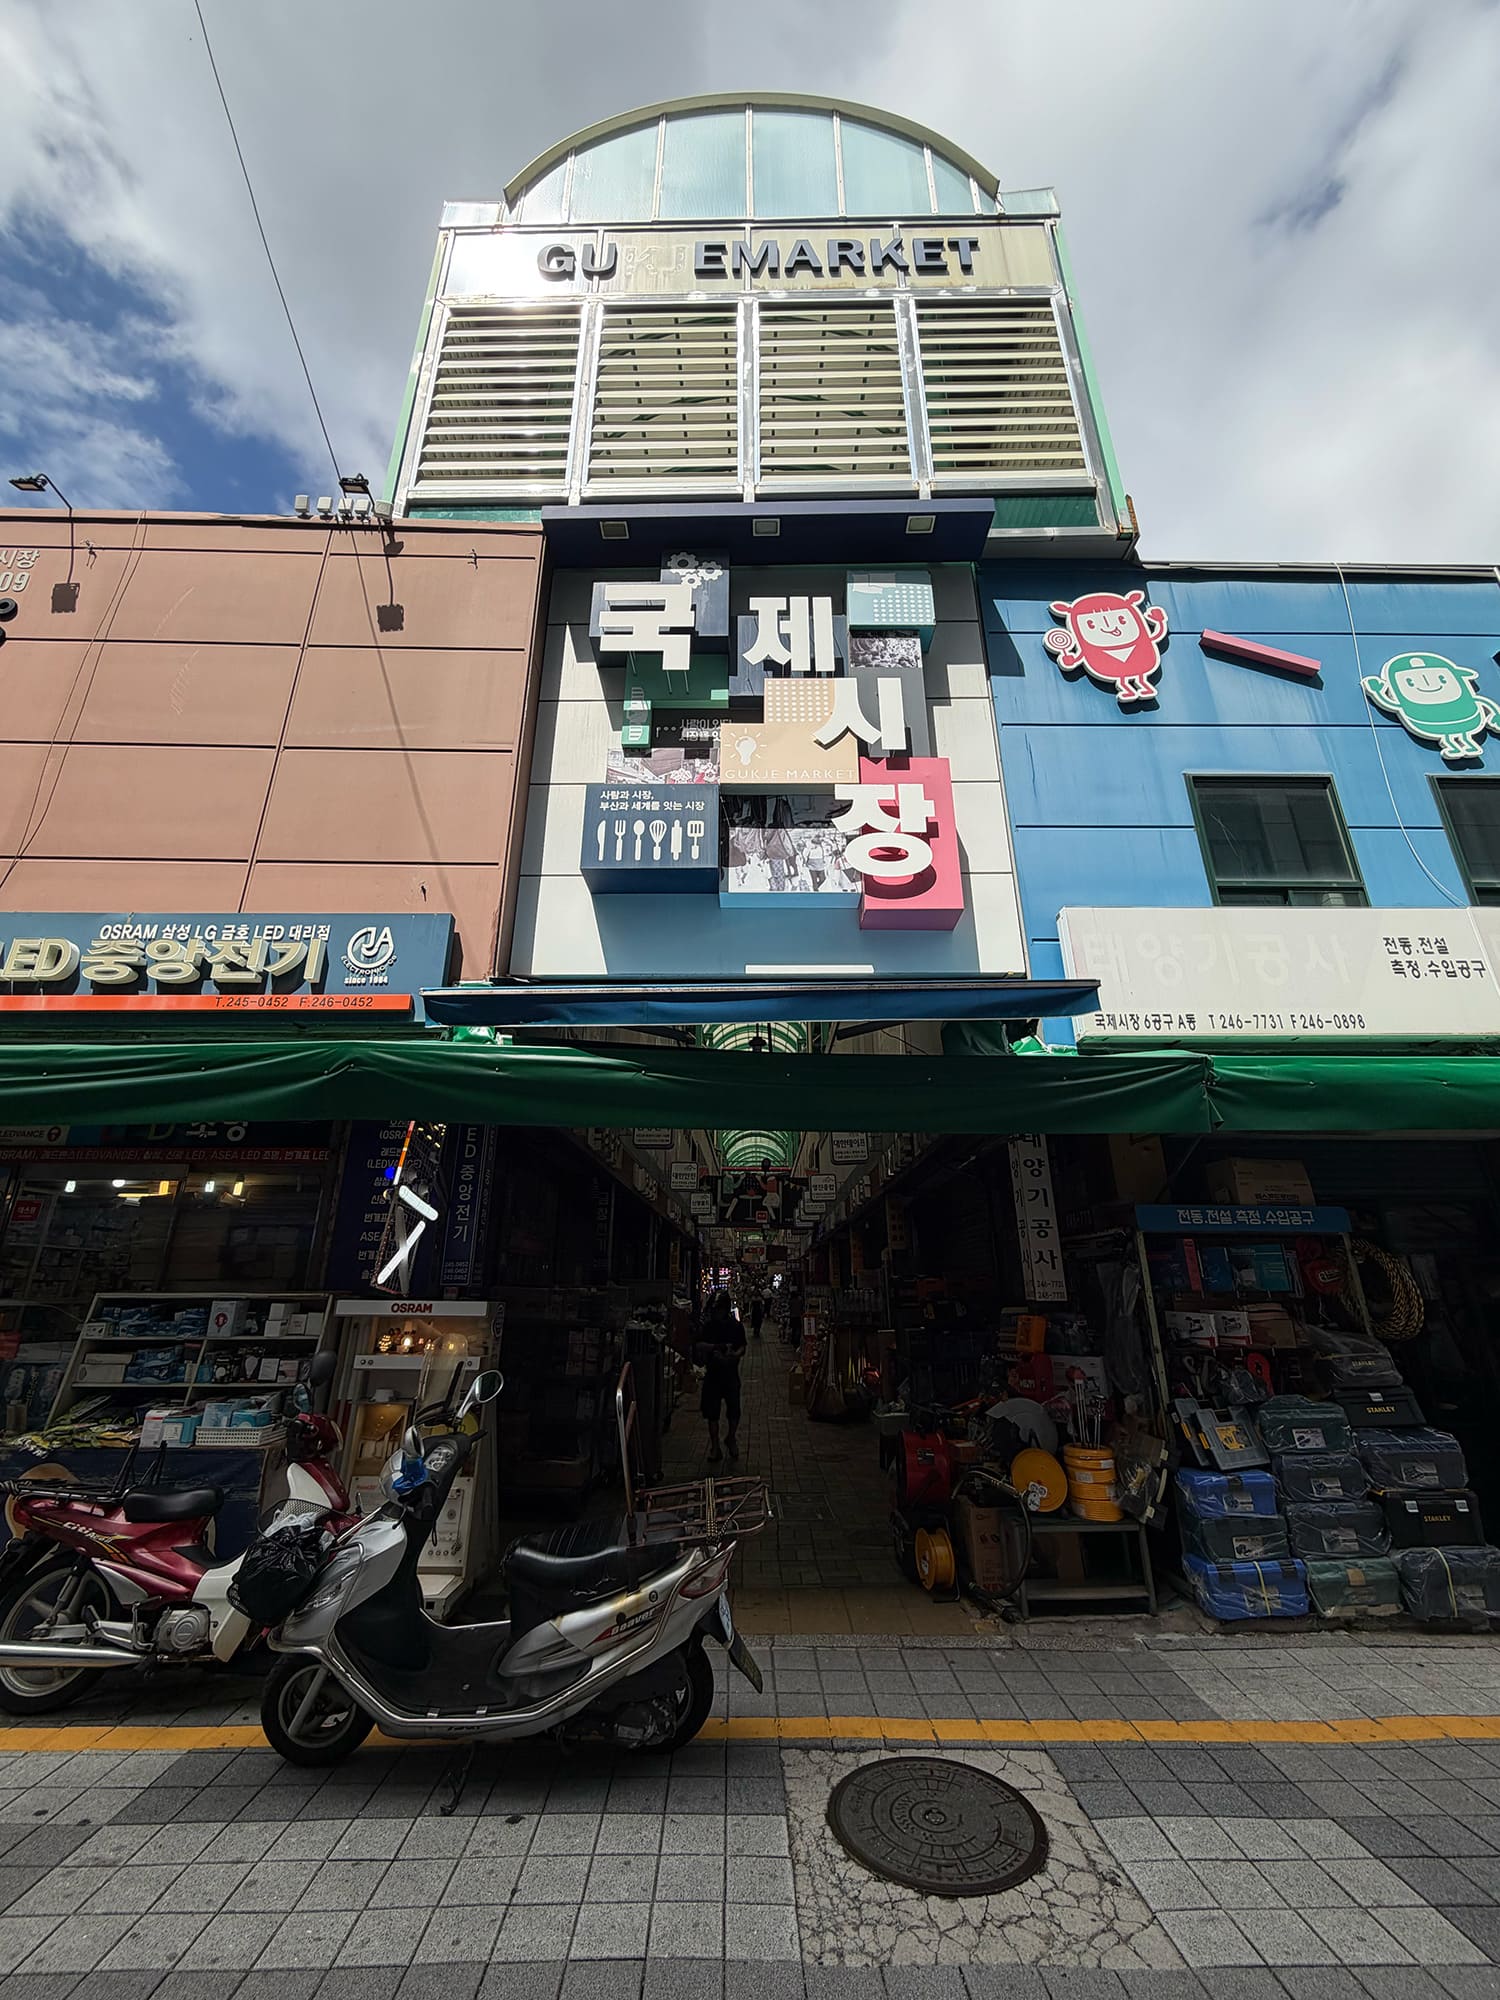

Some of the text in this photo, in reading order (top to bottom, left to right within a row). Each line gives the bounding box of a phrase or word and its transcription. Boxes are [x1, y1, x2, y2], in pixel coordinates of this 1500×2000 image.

[694, 237, 979, 279] EMARKET
[725, 769, 856, 779] GUKJE MARKET
[600, 790, 655, 800] 사람과 시장,
[600, 801, 705, 811] 부산과 세계를 잇는 시장
[100, 924, 331, 942] OSRAM 삼성 LG 금호 LED 대리점
[215, 997, 374, 1008] T.245-0452 F.246-0452
[1095, 1013, 1140, 1031] 국제시장
[1143, 1013, 1174, 1031] 6공구
[1177, 1013, 1197, 1031] A동
[1219, 1013, 1284, 1030] 246-7731
[1300, 1013, 1366, 1029] 246-0898
[391, 1303, 433, 1313] OSRAM
[1365, 1405, 1396, 1415] STANLEY
[1423, 1515, 1451, 1523] STANLEY
